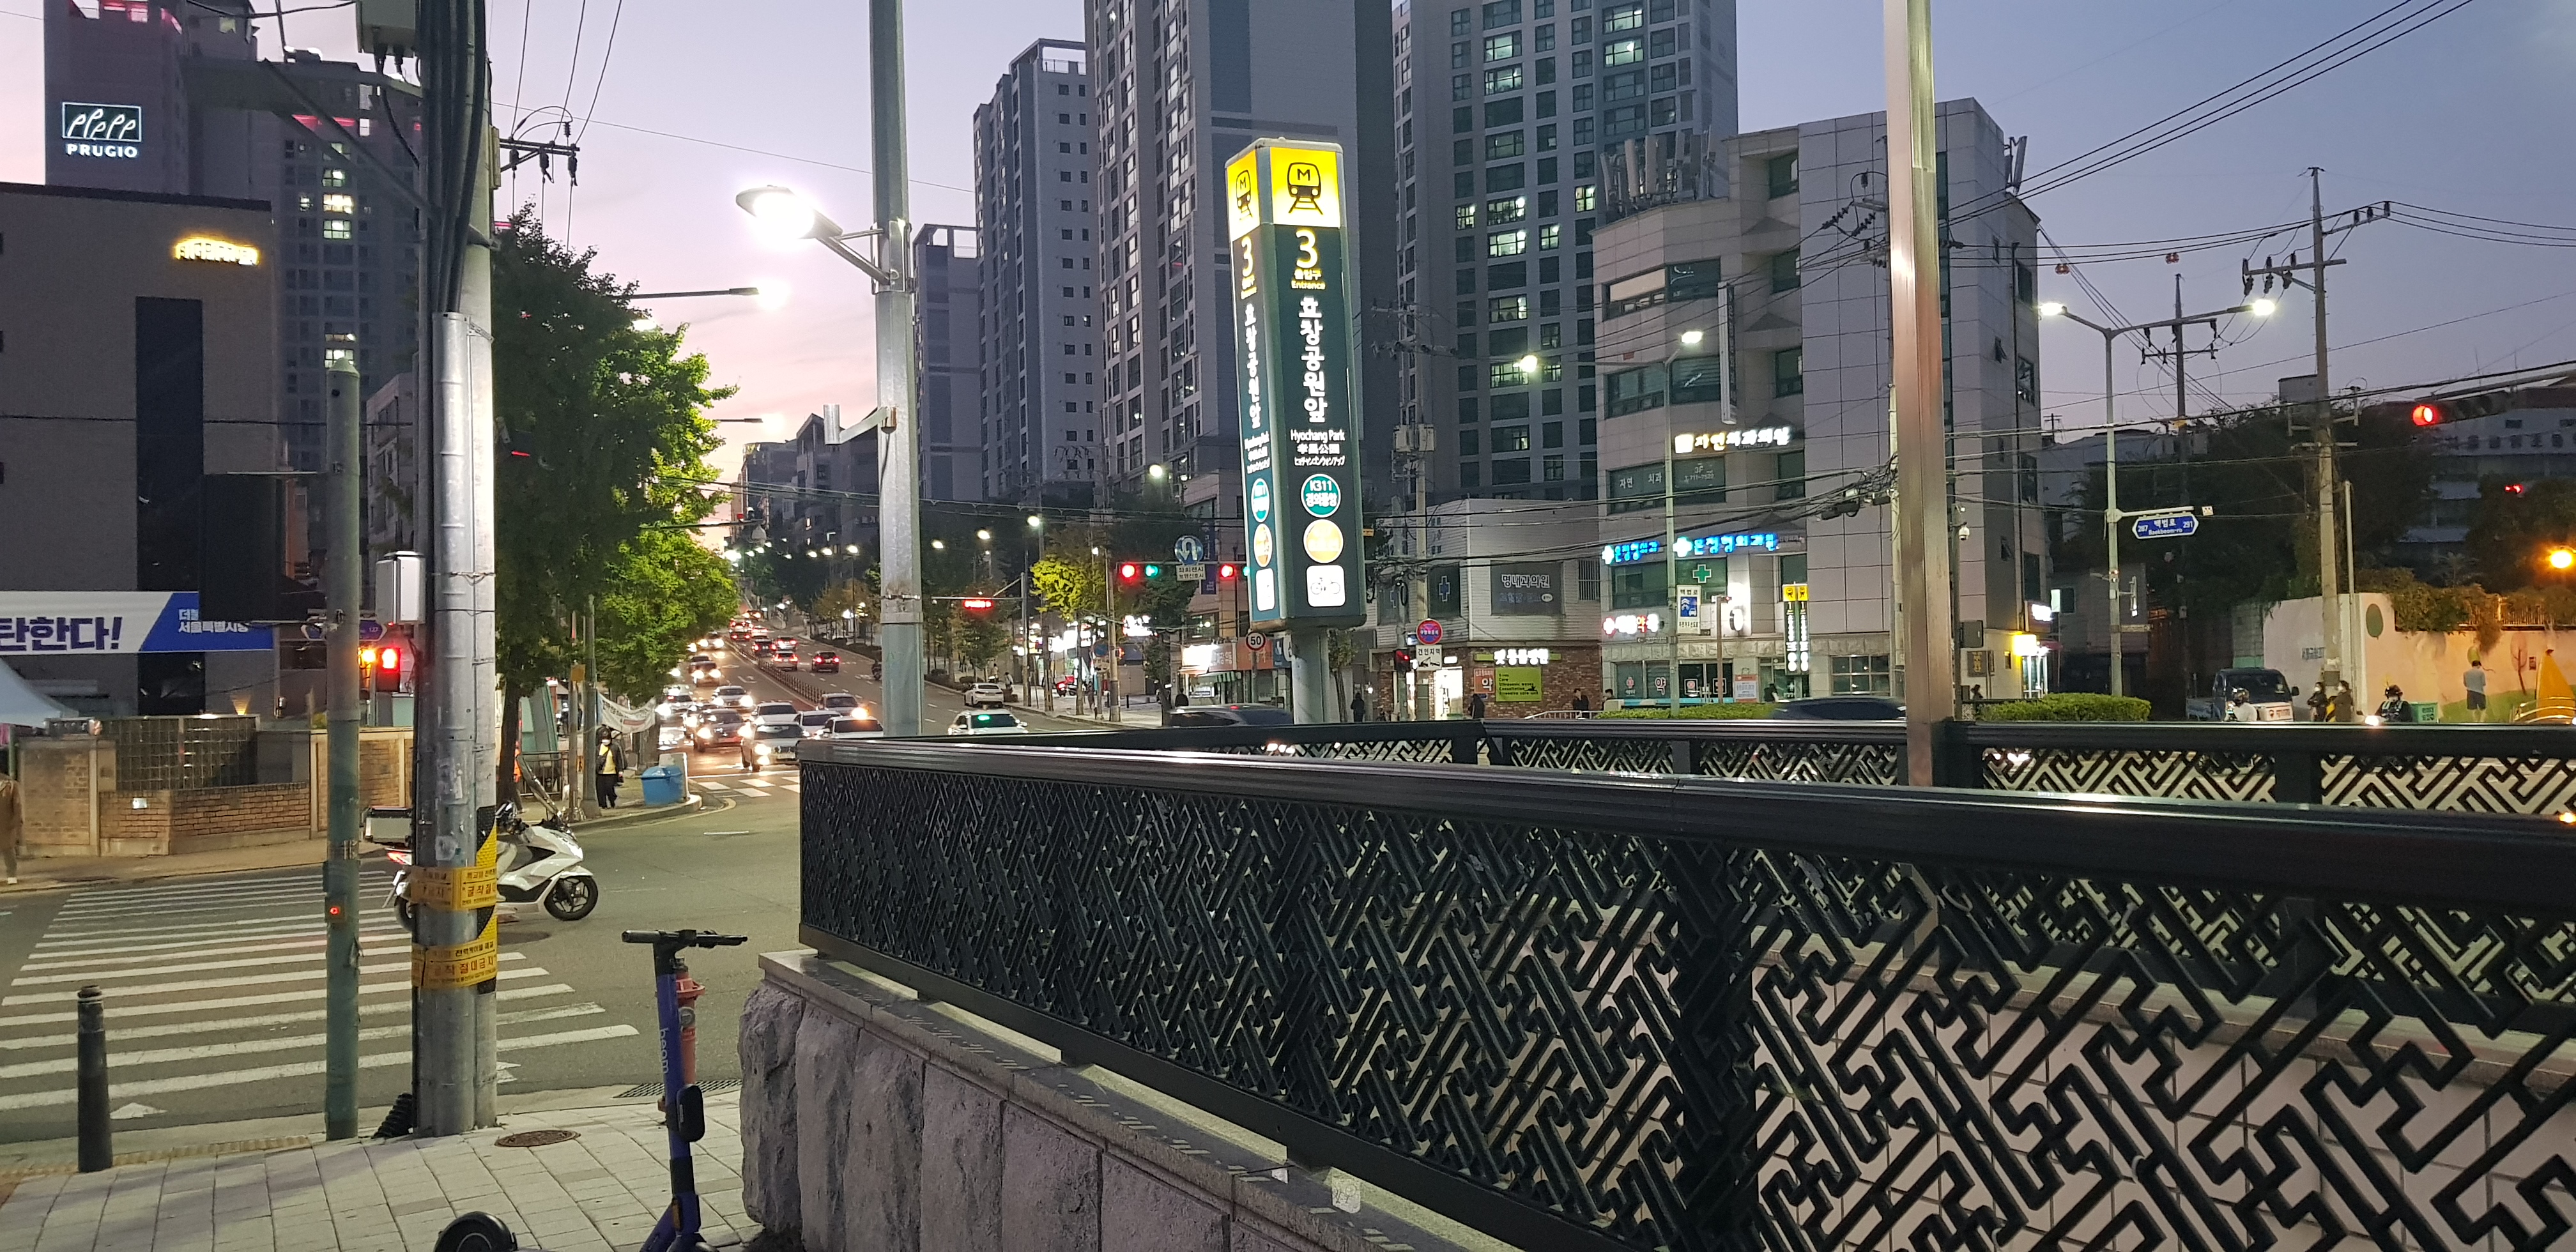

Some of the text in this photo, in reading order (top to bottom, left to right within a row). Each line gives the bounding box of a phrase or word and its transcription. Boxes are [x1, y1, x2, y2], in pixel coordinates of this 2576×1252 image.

[66, 143, 138, 158] PRUGIO
[1241, 236, 1254, 277] 3
[1296, 229, 1318, 269] 3
[1291, 280, 1326, 290] Entrance
[1245, 303, 1261, 429] 효창공원앞
[1298, 296, 1328, 423] 효창공원앞
[1290, 429, 1346, 443] Hyochang Park
[1309, 480, 1332, 491] K311
[1620, 472, 1662, 489] 자연 치과
[1305, 492, 1337, 507] 경의중앙
[2154, 519, 2177, 528] 백범로
[1501, 574, 1550, 588] 명내과의원
[0, 616, 122, 651] 탄한다!
[1250, 636, 1262, 645] 50
[1482, 677, 1493, 692] 약
[1655, 677, 1666, 695] 약
[659, 1027, 669, 1074] beam
